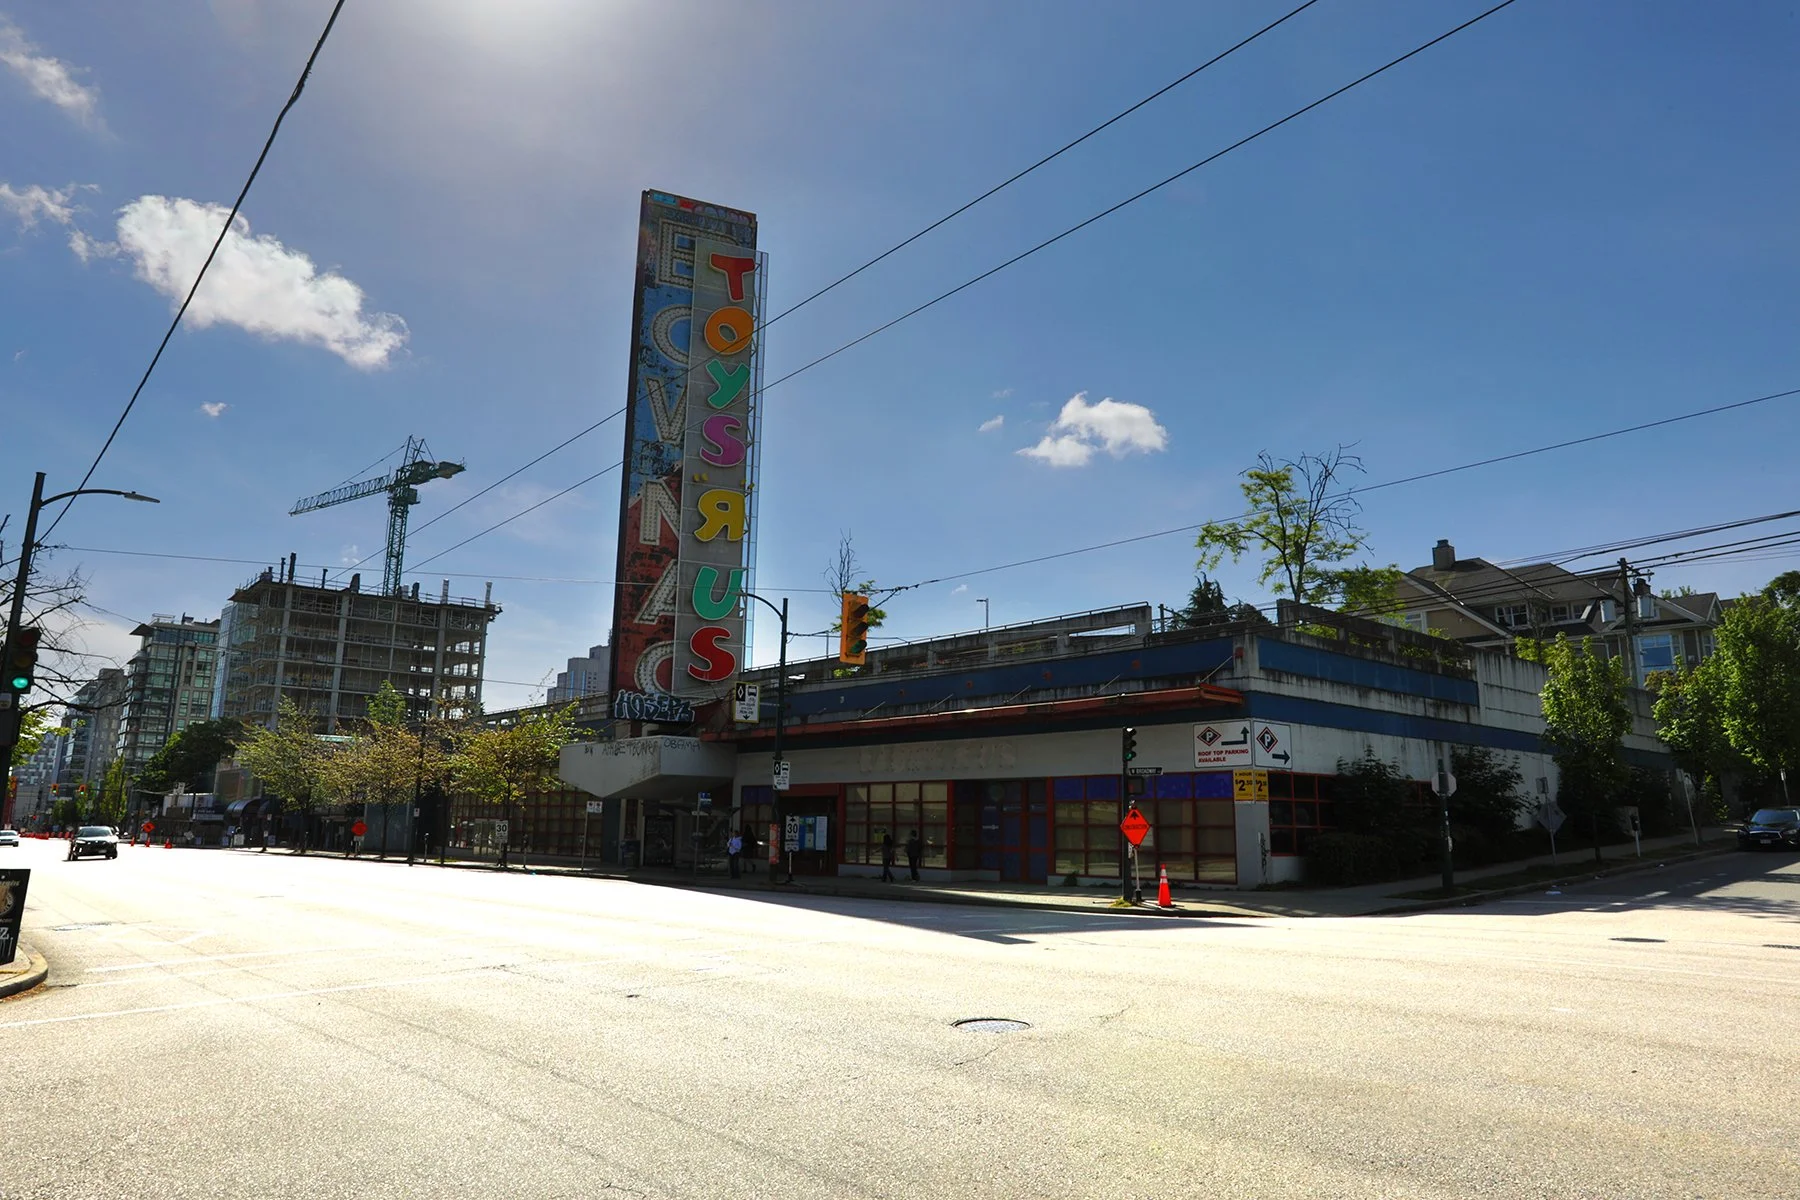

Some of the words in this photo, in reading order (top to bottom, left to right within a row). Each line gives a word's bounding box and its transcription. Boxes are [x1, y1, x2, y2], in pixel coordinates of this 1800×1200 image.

[1206, 731, 1213, 742] P
[1264, 733, 1271, 746] P
[496, 823, 508, 832] 30
[787, 823, 798, 834] 30
